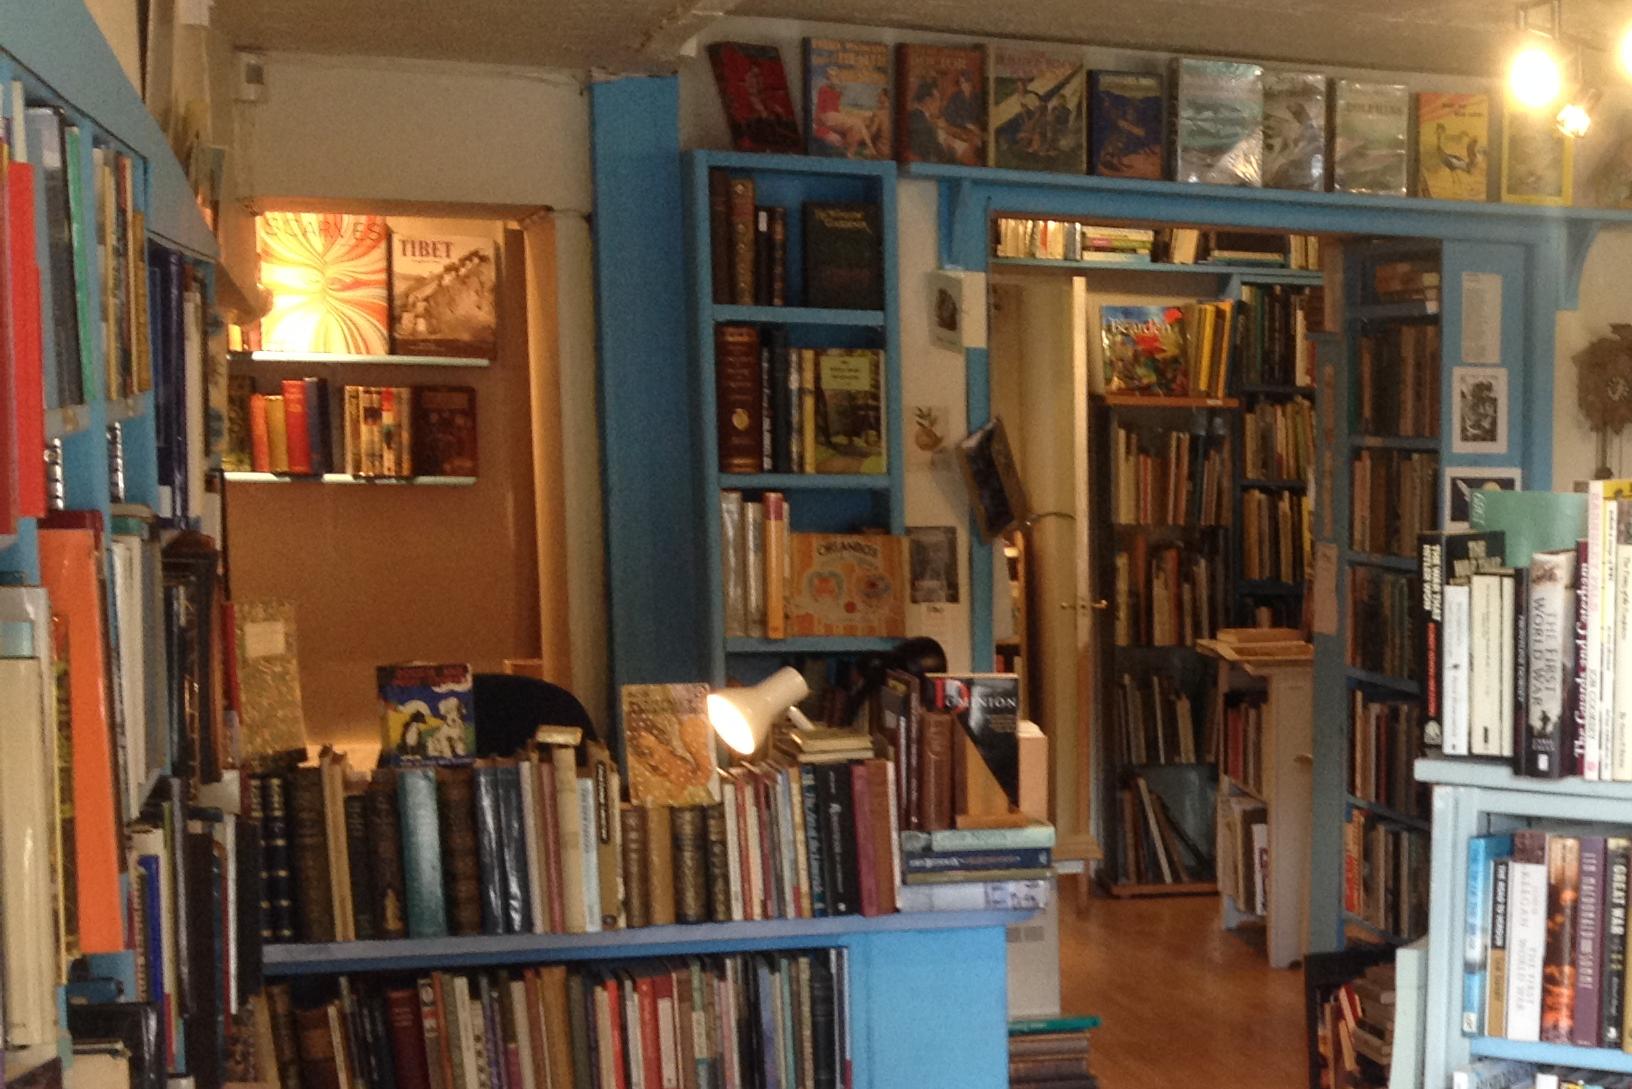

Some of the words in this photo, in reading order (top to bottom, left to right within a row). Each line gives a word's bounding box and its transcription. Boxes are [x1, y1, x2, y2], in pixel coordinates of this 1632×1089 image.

[264, 217, 384, 241] SCARVES
[399, 238, 454, 258] TIBET
[1422, 544, 1432, 581] HITLER
[1431, 593, 1442, 621] THAT
[1532, 597, 1546, 661] WORLD
[1545, 612, 1558, 640] THE
[1532, 666, 1544, 706] WAR
[1545, 647, 1558, 693] FIRST
[1497, 864, 1506, 880] THE
[1613, 864, 1626, 904] GREAT
[1495, 903, 1504, 913] TO
[1496, 881, 1505, 902] ROAD
[1520, 871, 1531, 928] KEEGAN
[1581, 876, 1596, 937] MACDONALD
[1494, 914, 1504, 947] VERDUN
[1612, 907, 1624, 935] WAR
[1578, 954, 1593, 990] SOMME
